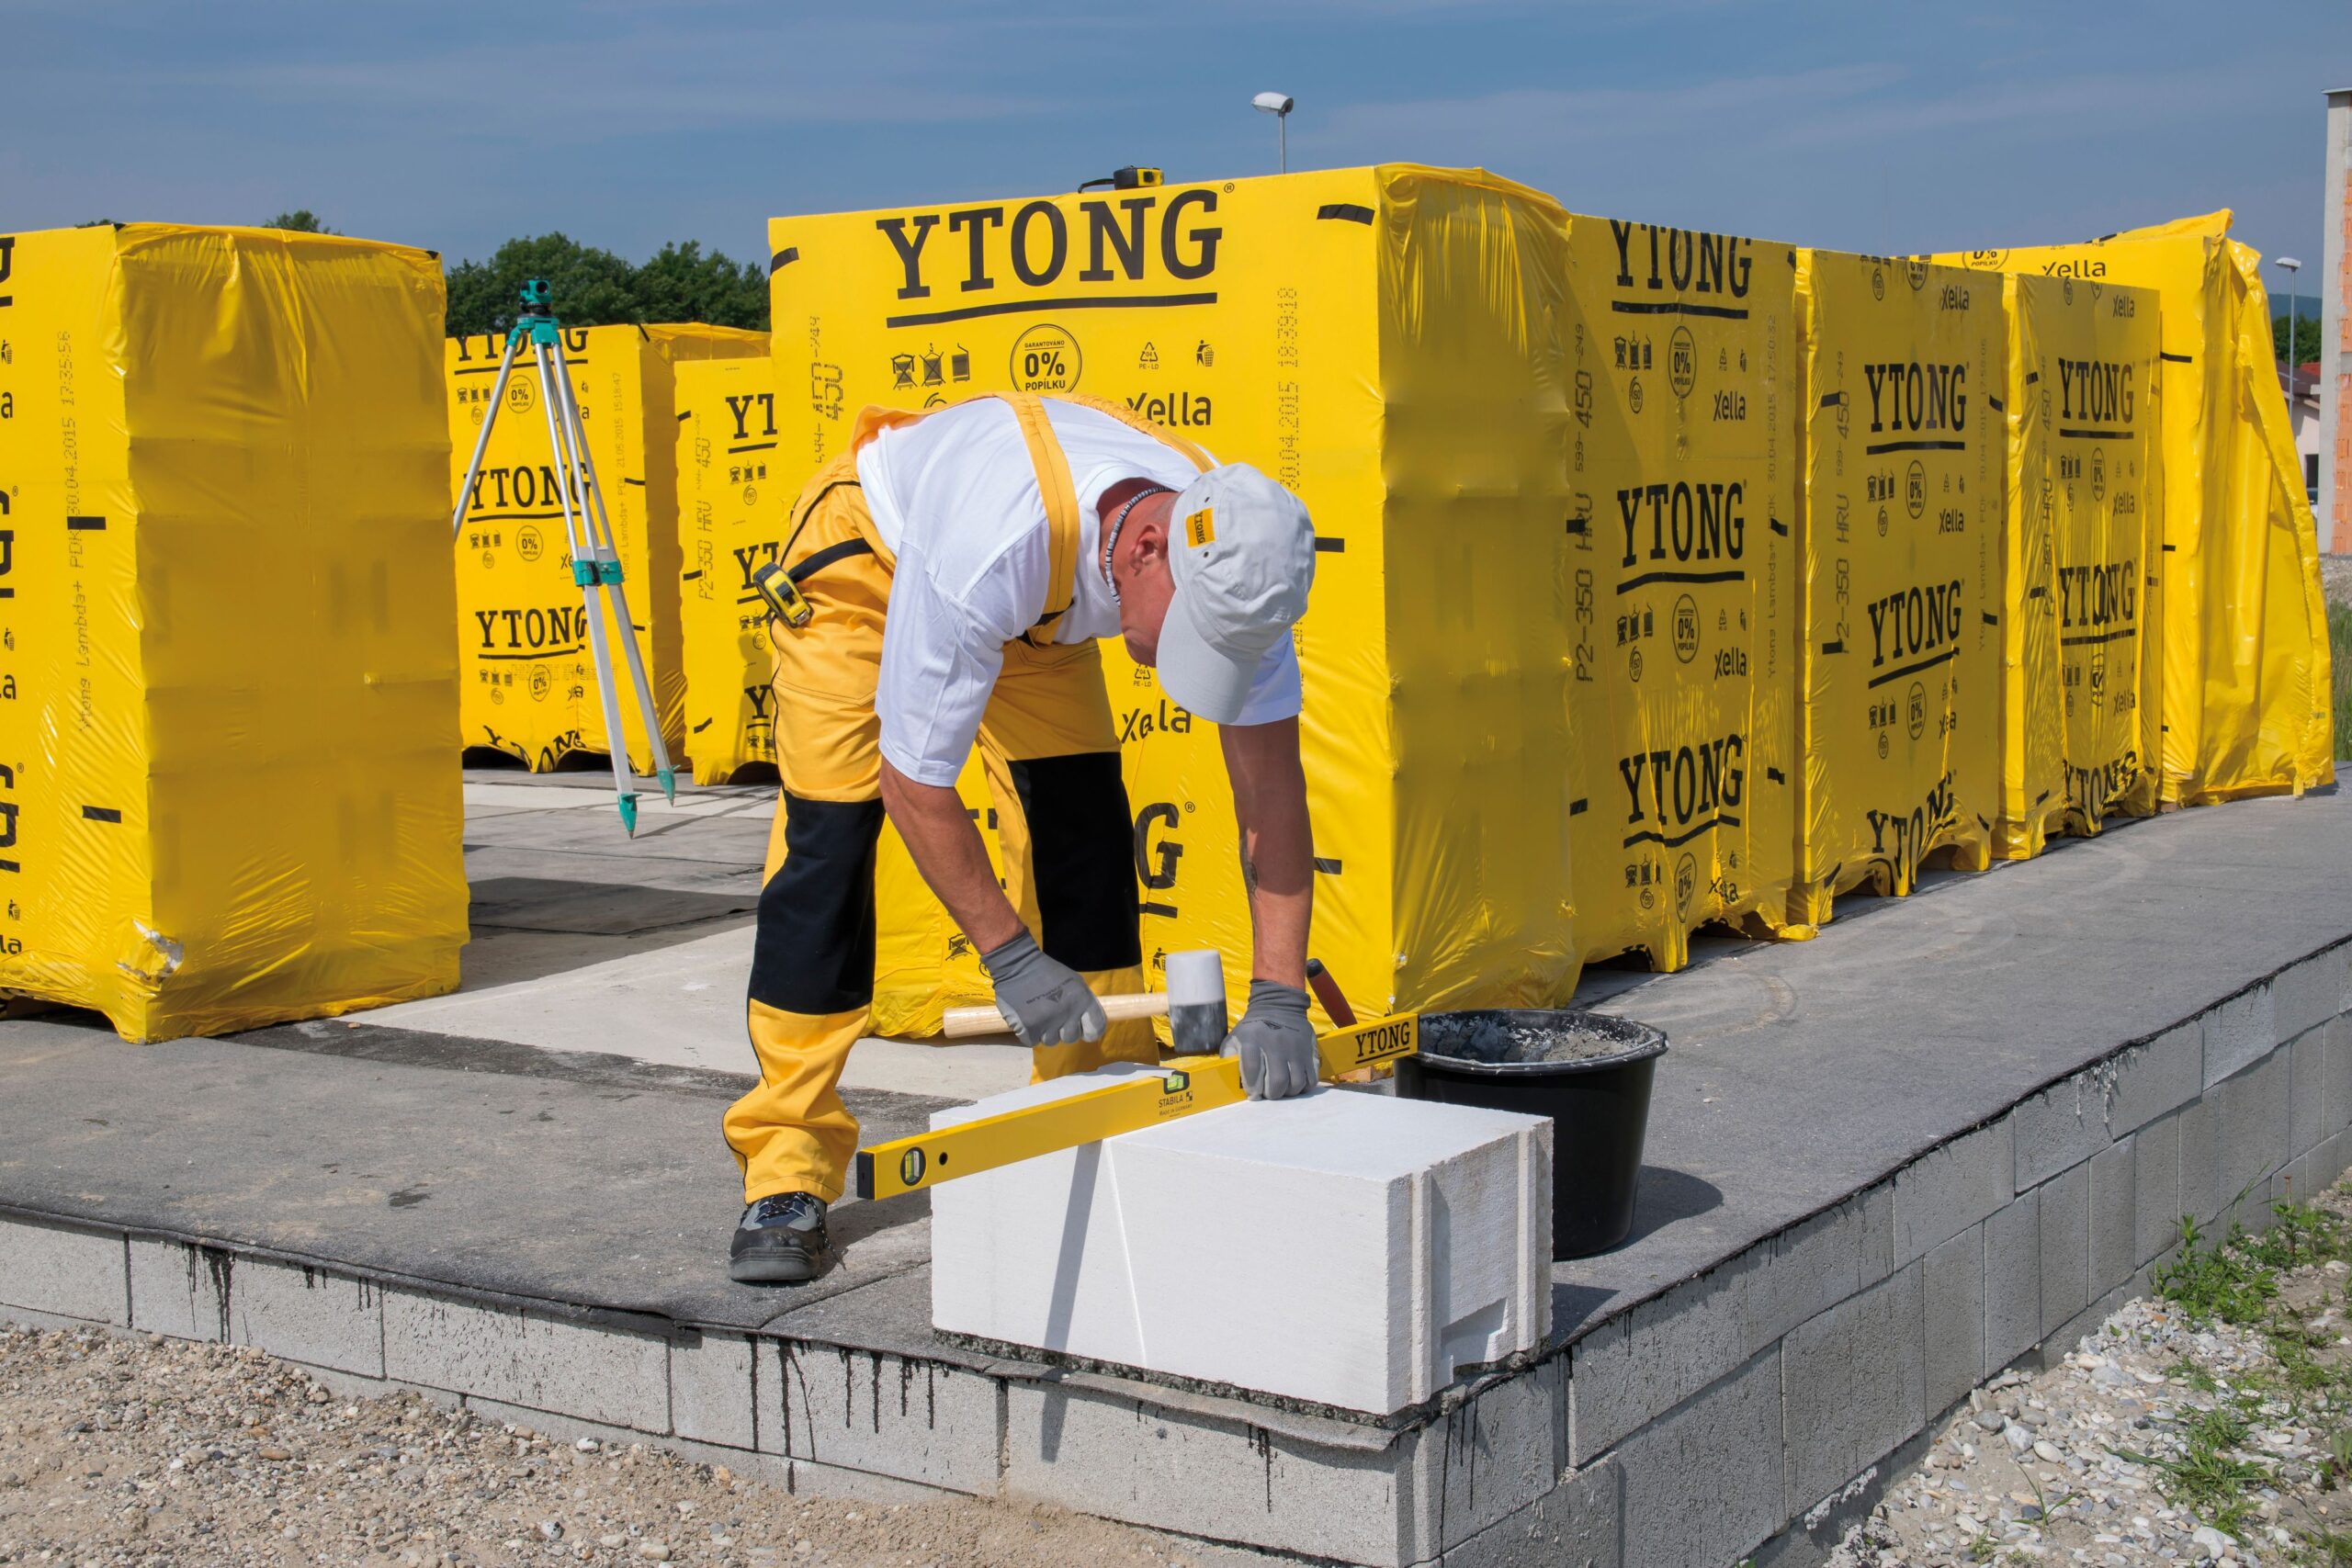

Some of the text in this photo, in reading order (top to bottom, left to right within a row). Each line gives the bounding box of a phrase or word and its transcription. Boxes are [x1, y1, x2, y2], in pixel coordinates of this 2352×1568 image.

[876, 189, 1223, 300] YTONG
[1610, 219, 1753, 298] YTONG
[1941, 284, 1970, 310] Xella
[57, 331, 75, 406] 17:35:56
[1025, 351, 1066, 378] 0%
[1673, 351, 1690, 375] 0%
[1025, 379, 1066, 392] POPÍLKU
[1713, 389, 1747, 422] Xella
[1864, 362, 1966, 433] YTONG
[2058, 357, 2134, 423] YTONG
[62, 418, 81, 517] 30.04.2015
[1910, 480, 1922, 499] 0%
[1194, 511, 1206, 546] YTONG
[1617, 480, 1745, 569] YTONG
[1836, 493, 1849, 544] HRU
[1939, 508, 1964, 535] Xella
[521, 538, 537, 549] 0%
[2059, 560, 2135, 627] YTONG
[1575, 569, 1593, 683] P2-350
[1678, 617, 1695, 640] 0%
[1868, 580, 1961, 668] YTONG
[1713, 647, 1747, 681] Xella
[1620, 734, 1743, 825] YTONG
[1355, 1021, 1411, 1061] YTONG
[1158, 1094, 1184, 1109] STABILA
